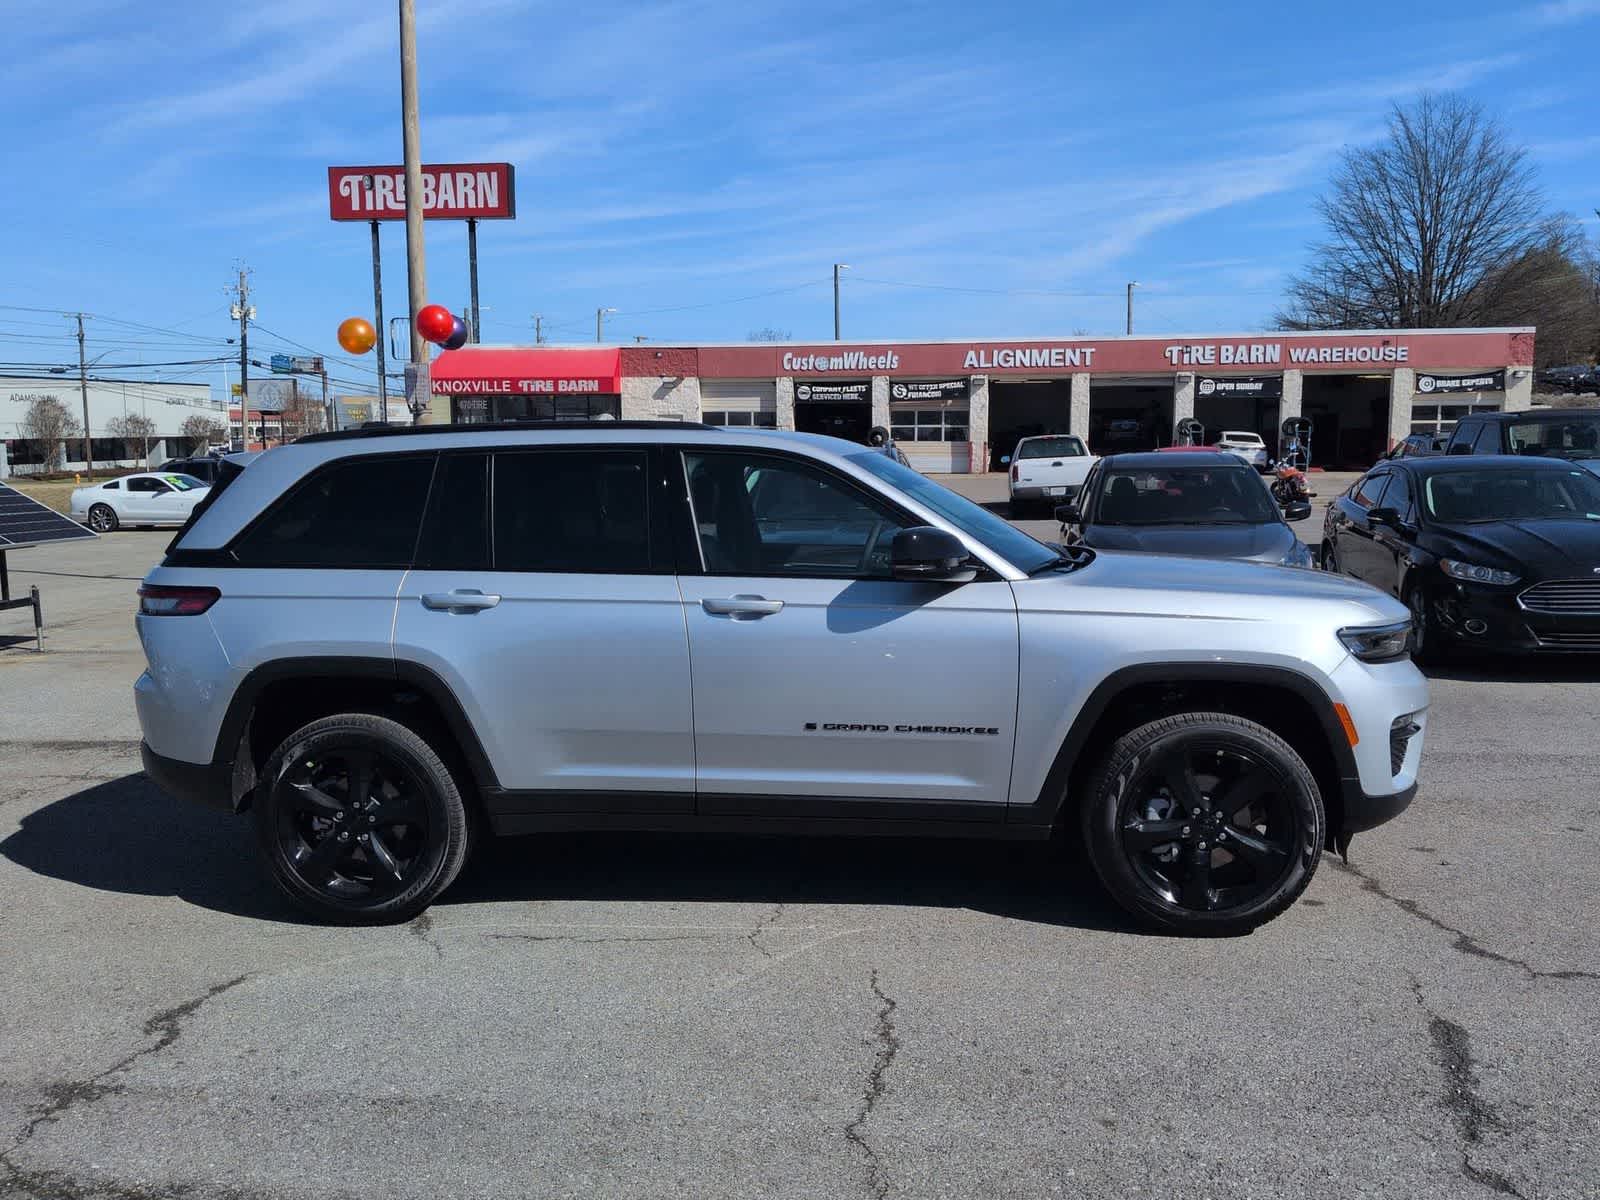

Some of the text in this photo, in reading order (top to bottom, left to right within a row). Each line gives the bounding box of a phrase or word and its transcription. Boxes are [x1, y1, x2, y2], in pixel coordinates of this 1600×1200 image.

[421, 171, 500, 210] BARN
[963, 348, 1096, 369] ALIGNMENT
[1219, 344, 1282, 365] BARN
[1289, 346, 1410, 363] WAREHOUSE
[431, 379, 512, 393] KNOXVILLE
[558, 379, 599, 392] BARN
[1216, 382, 1235, 390] OPEN
[822, 722, 1000, 736] GRAND CHEROKEE
